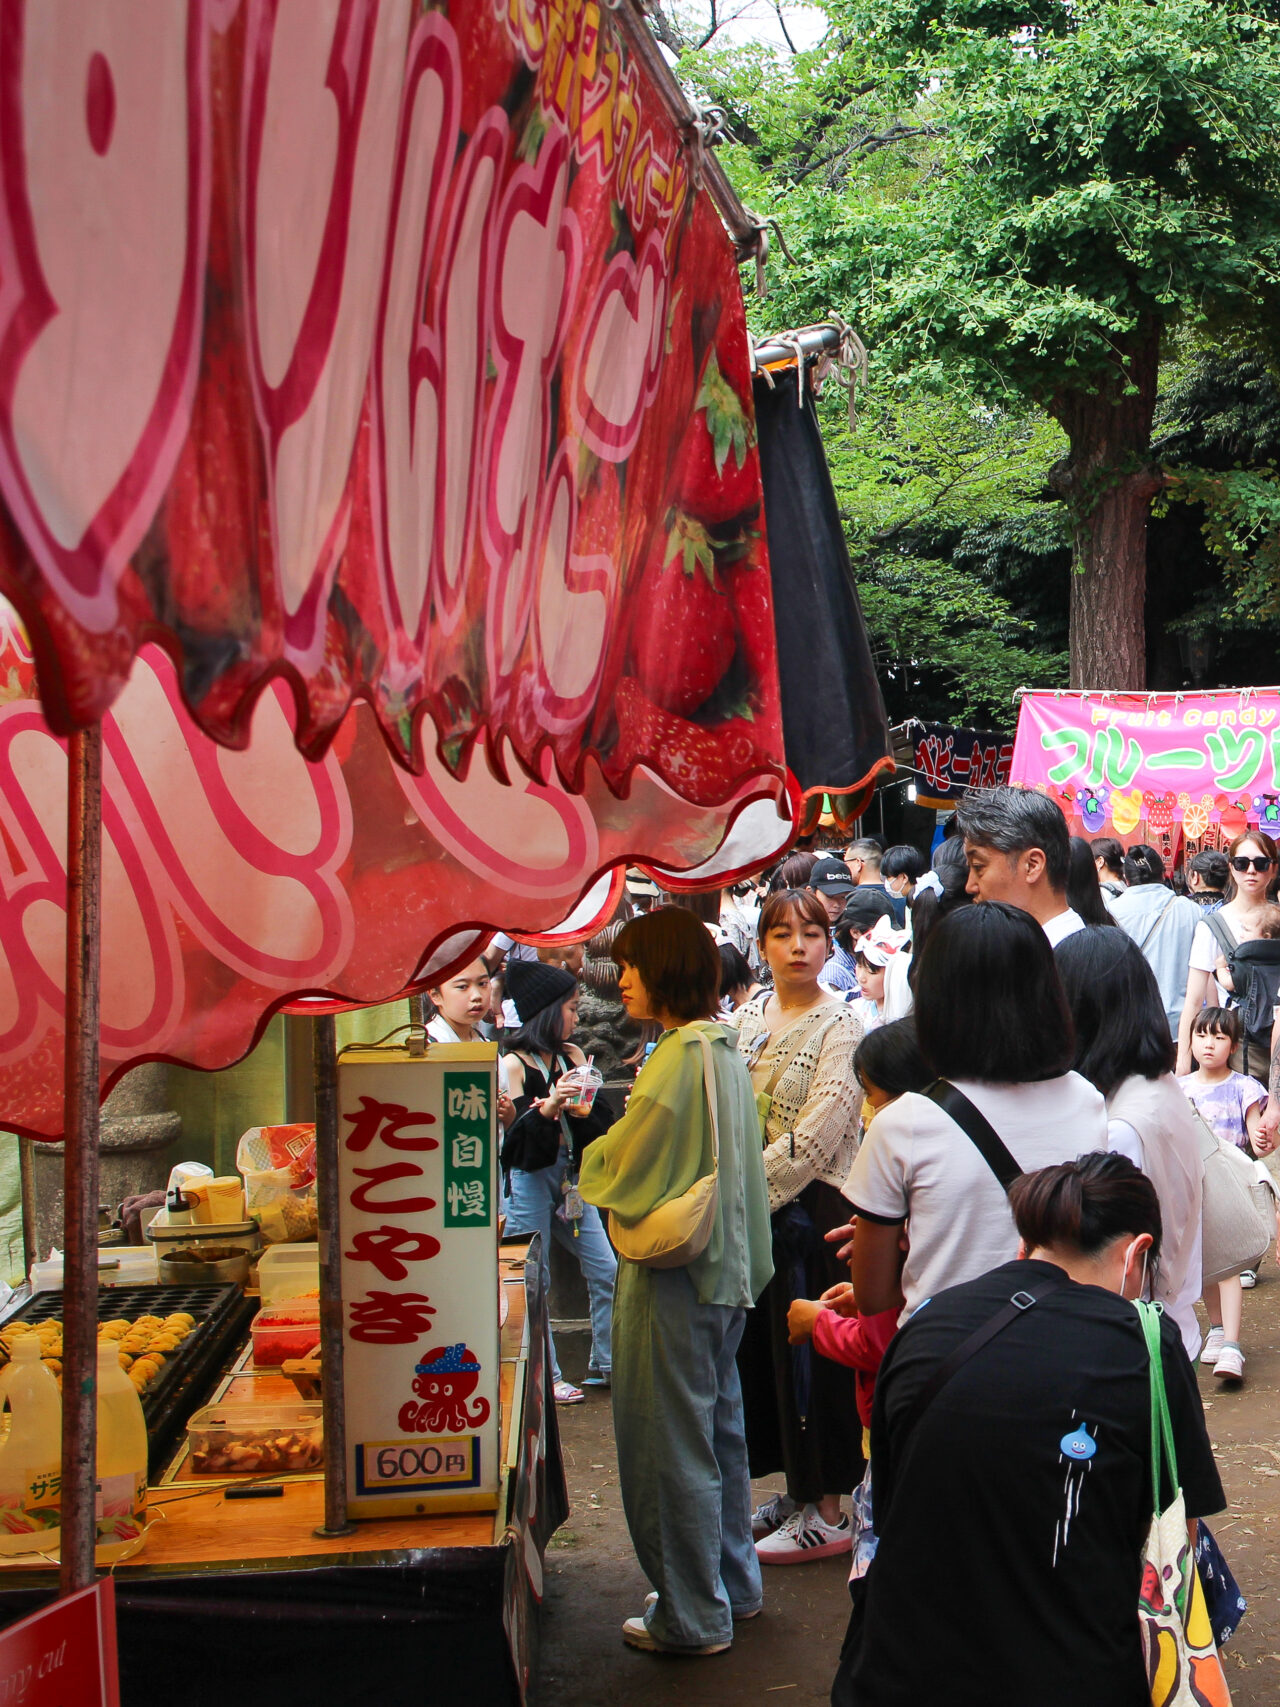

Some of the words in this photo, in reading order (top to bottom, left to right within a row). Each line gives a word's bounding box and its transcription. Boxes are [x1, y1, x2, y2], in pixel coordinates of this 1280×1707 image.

[1090, 708, 1172, 727] Fruit
[1183, 706, 1277, 727] Candy
[447, 1084, 489, 1219] 味自慢
[343, 1096, 441, 1345] たこやき
[376, 1446, 466, 1479] 600円
